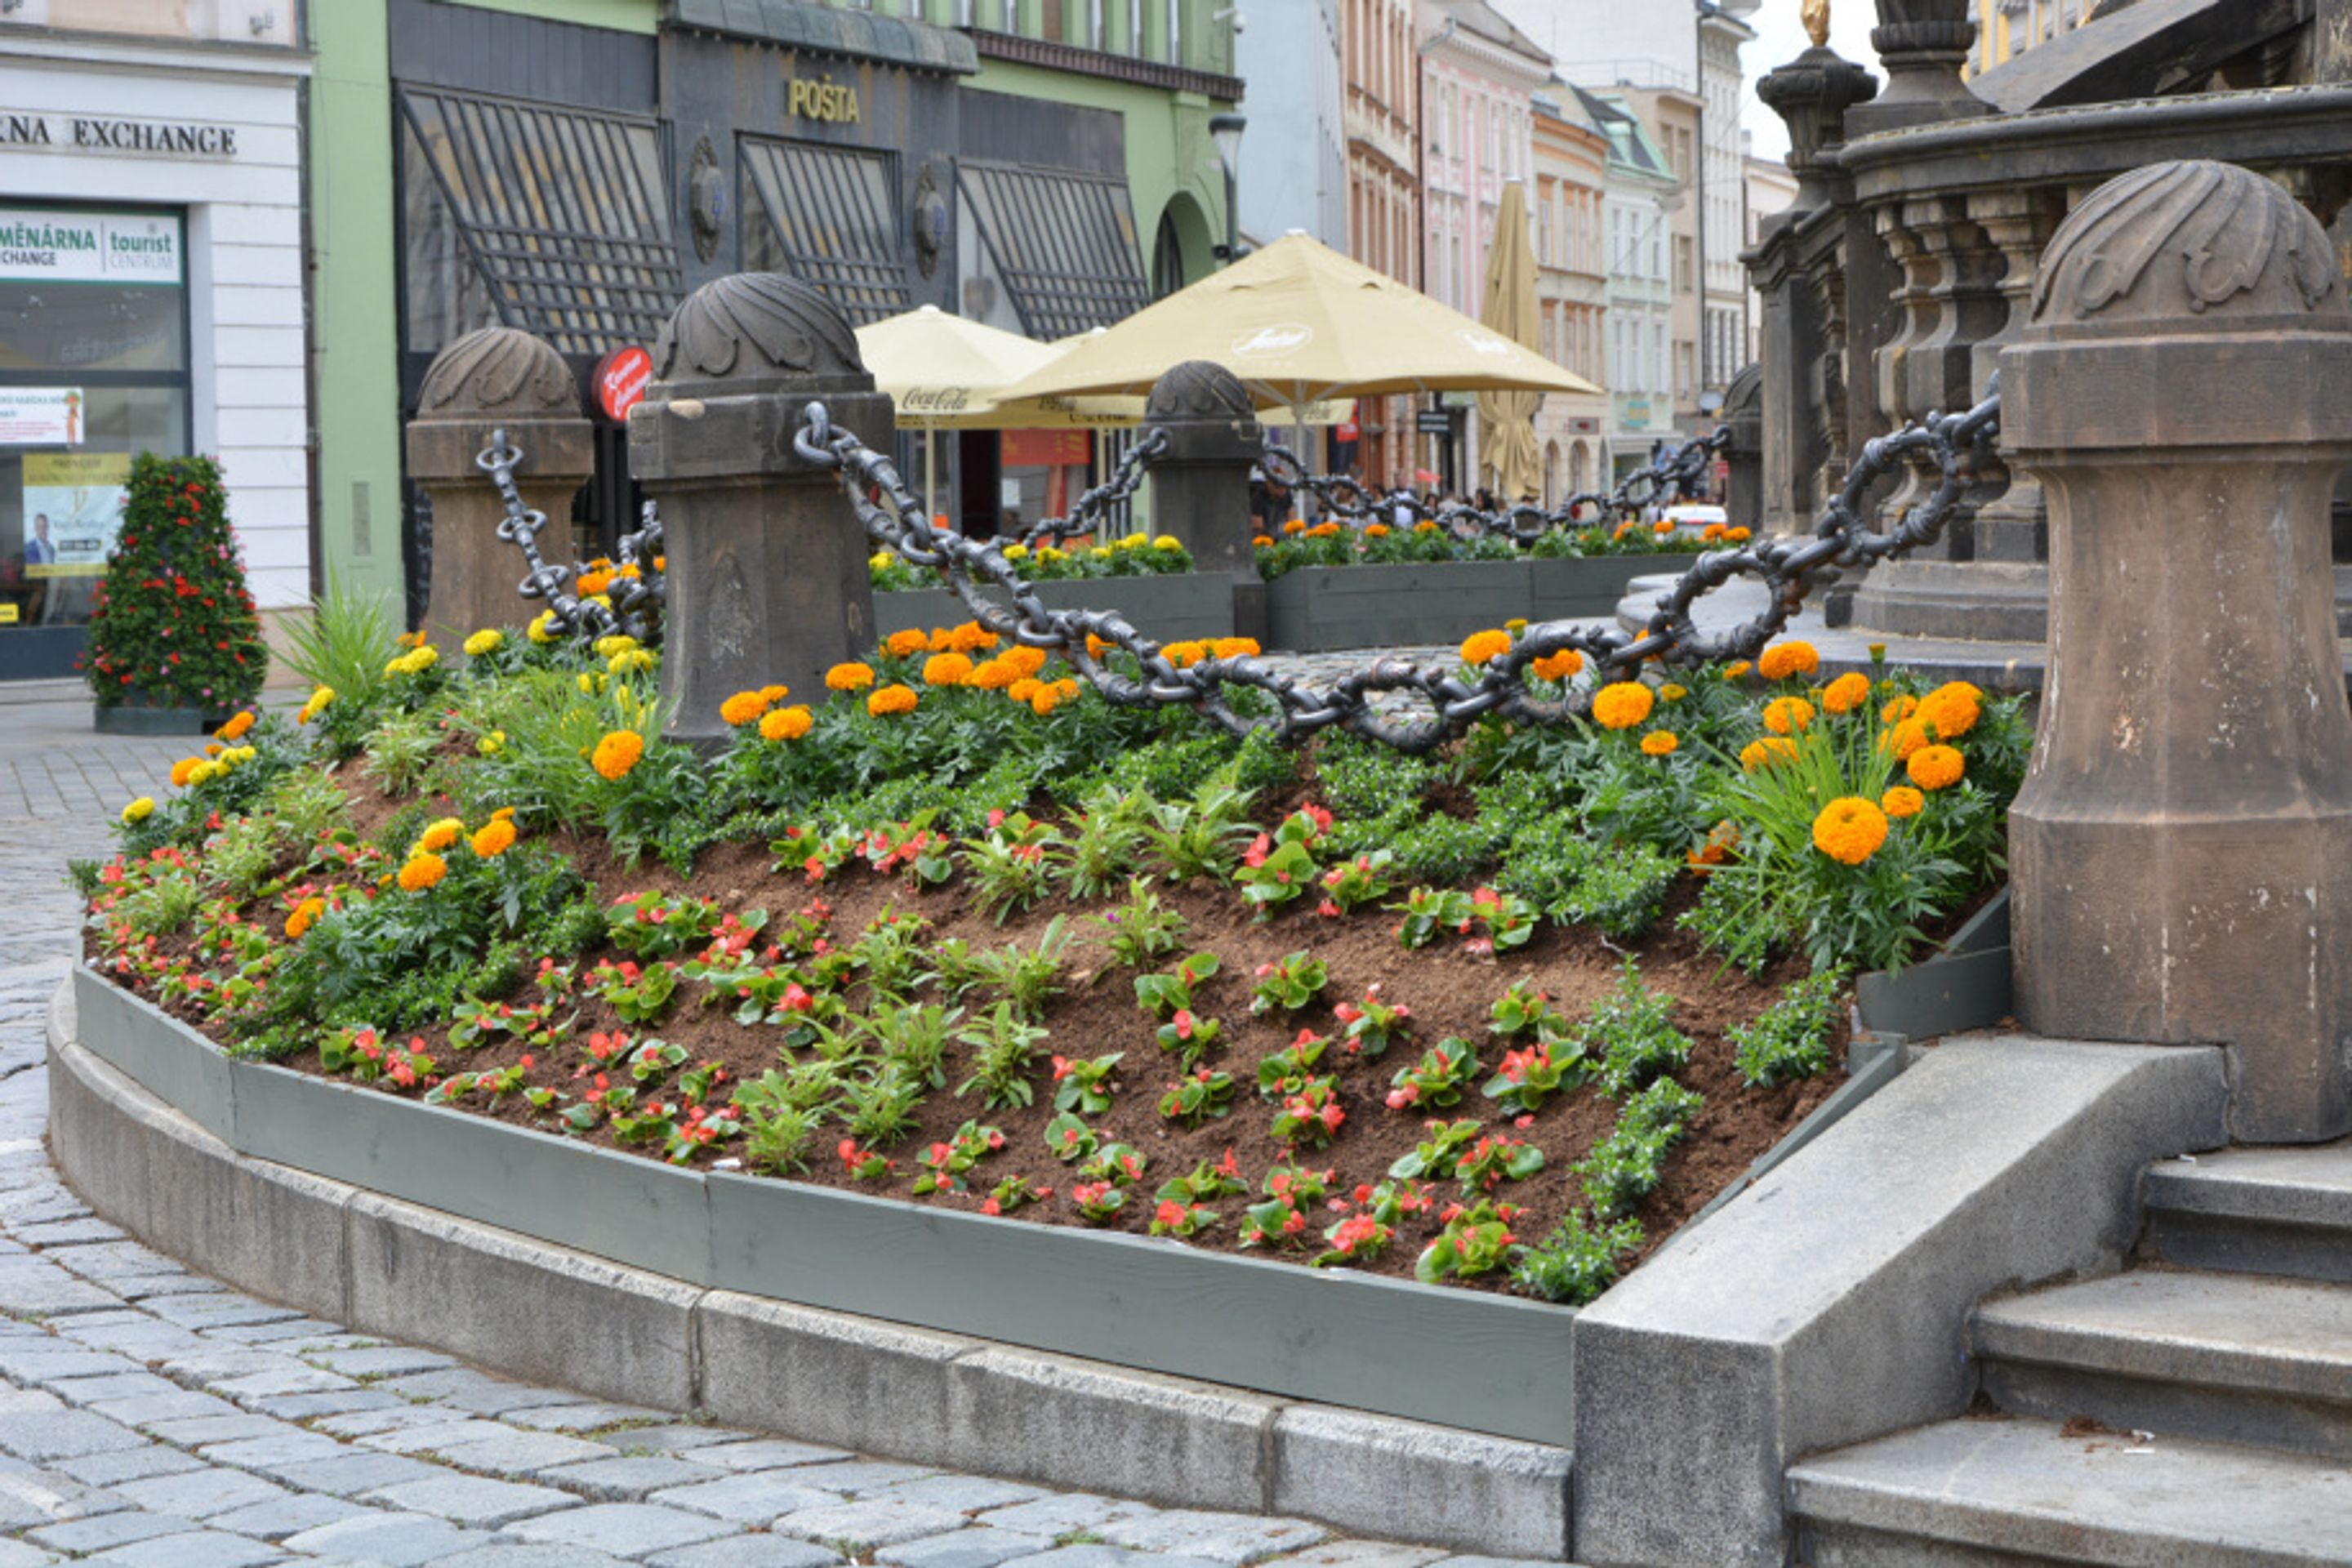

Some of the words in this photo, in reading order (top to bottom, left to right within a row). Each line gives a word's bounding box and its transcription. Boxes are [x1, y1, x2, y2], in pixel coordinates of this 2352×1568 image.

[789, 73, 860, 122] POŠTA
[72, 119, 237, 155] EXCHANGE
[110, 228, 172, 253] tourist
[110, 254, 174, 270] CENTRUM
